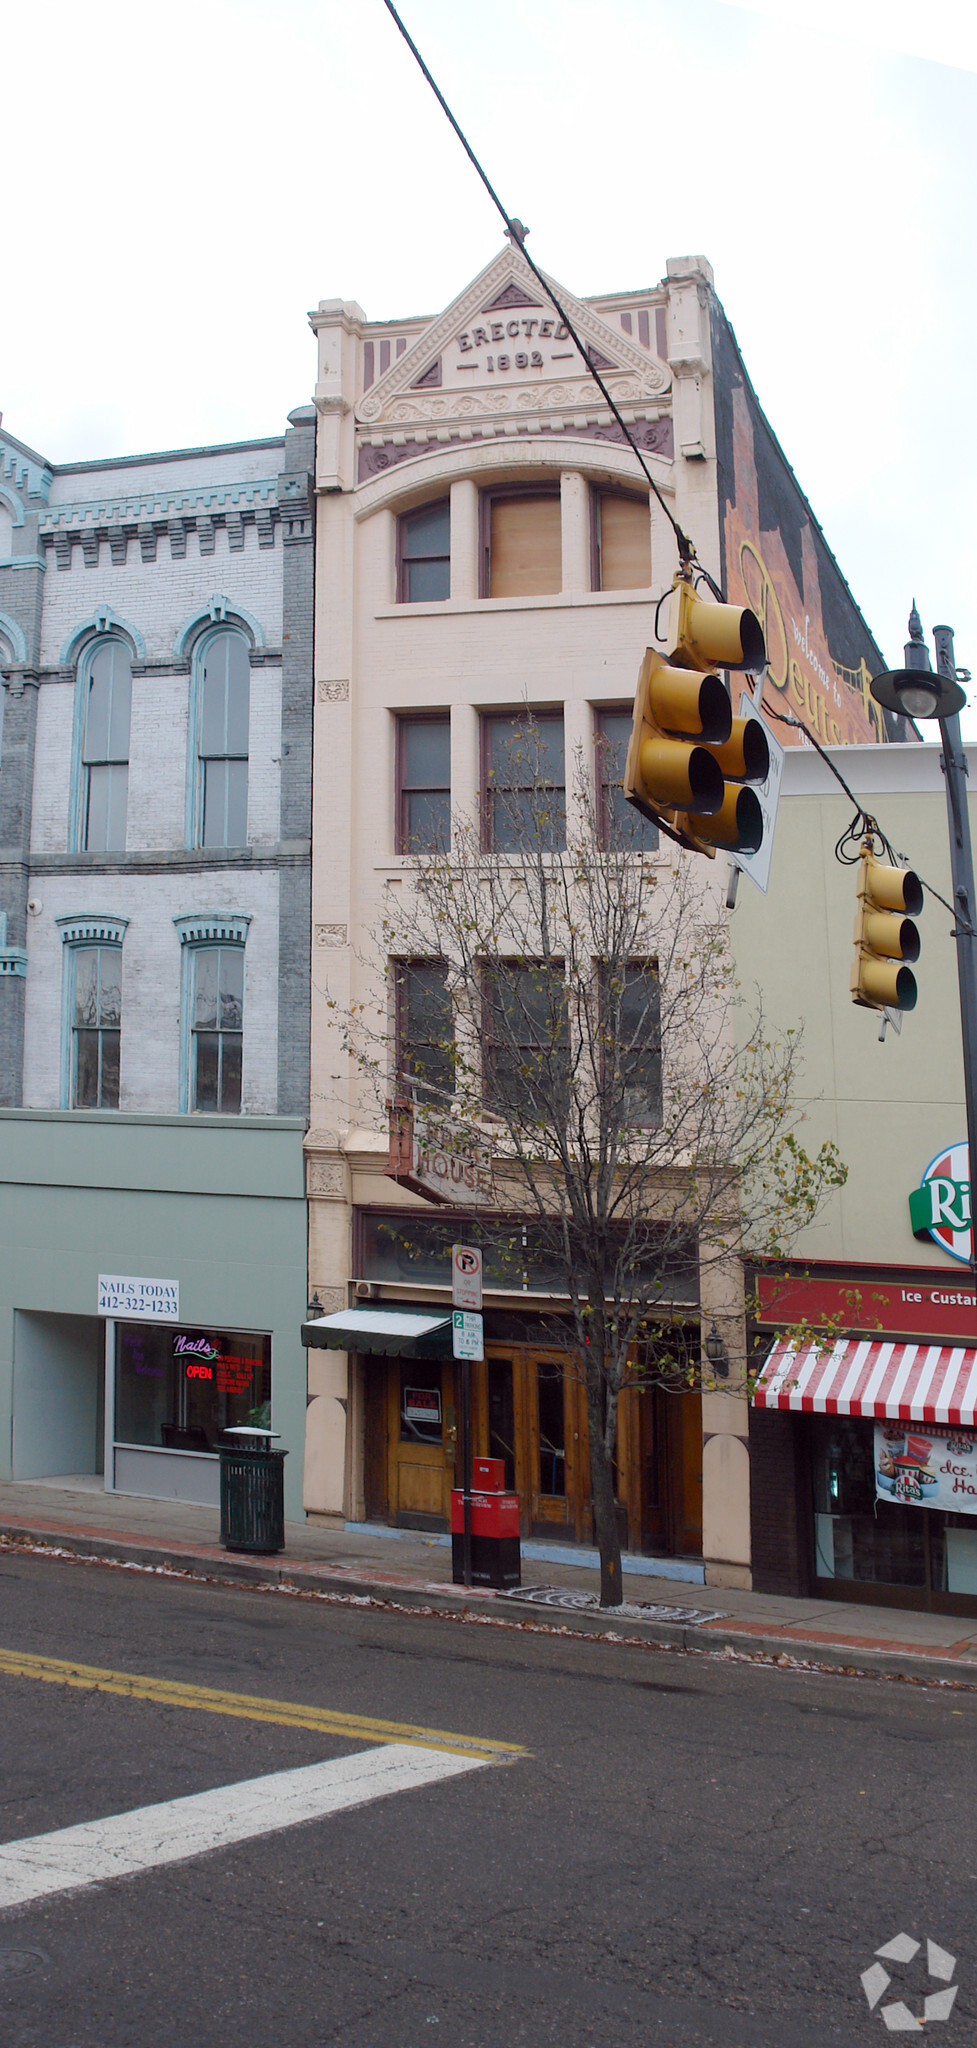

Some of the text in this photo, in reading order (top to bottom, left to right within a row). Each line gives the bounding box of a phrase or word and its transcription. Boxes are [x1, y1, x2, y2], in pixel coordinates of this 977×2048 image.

[456, 318, 570, 353] ERECTED
[487, 350, 544, 372] 1892
[417, 1145, 492, 1193] HOUSE
[99, 1281, 178, 1297] NAILS TODAY
[901, 1289, 922, 1303] Ice
[99, 1296, 178, 1314] 412-322-1233
[455, 1314, 463, 1328] 2
[173, 1334, 212, 1353] Nails
[186, 1365, 212, 1380] OPEN
[412, 1391, 432, 1400] FOR
[408, 1399, 437, 1409] SALE
[895, 1482, 921, 1497] Rita's
